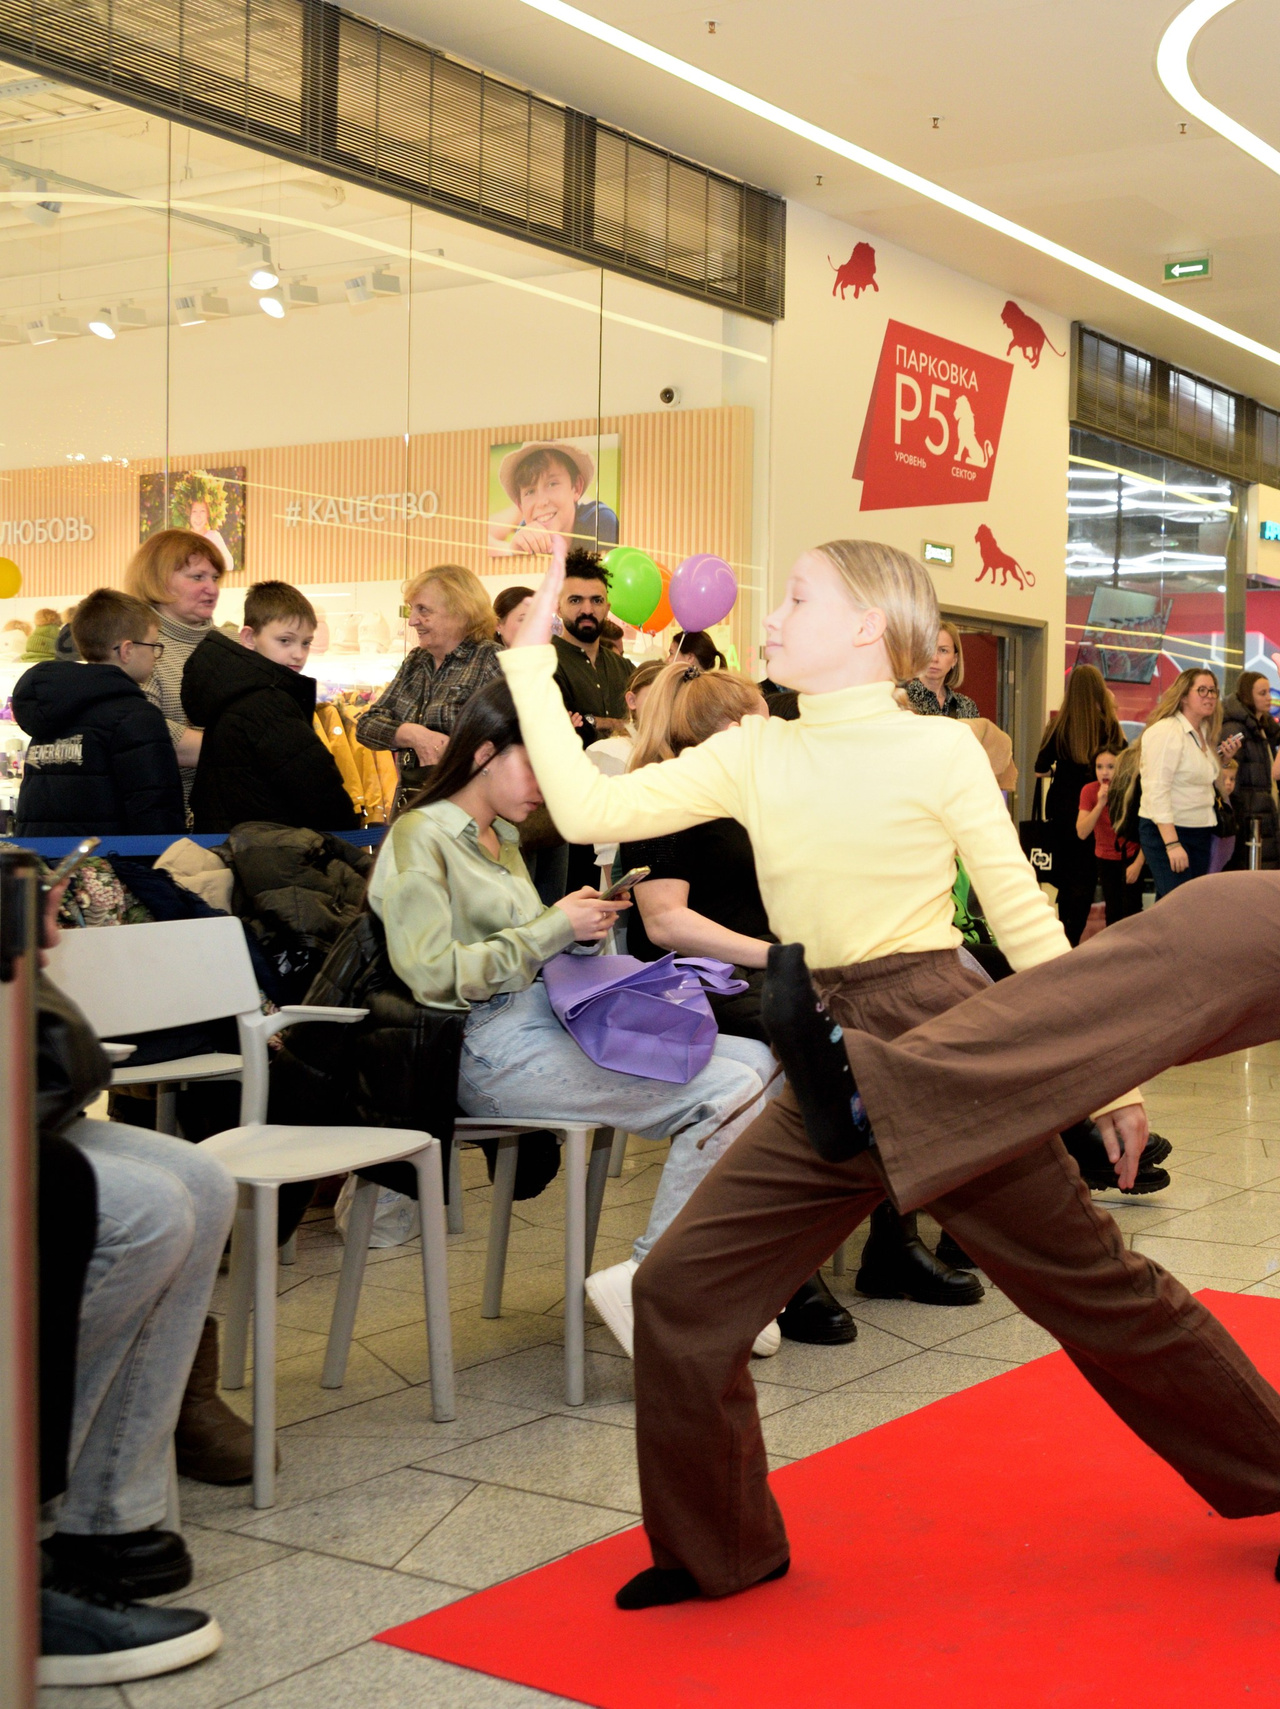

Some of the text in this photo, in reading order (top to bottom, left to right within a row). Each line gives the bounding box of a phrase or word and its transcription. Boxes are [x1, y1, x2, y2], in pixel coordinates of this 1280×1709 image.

[896, 344, 979, 392] ПАРКОВКА
[894, 372, 950, 456] P5
[894, 450, 927, 469] УРОВЕНЬ
[951, 466, 977, 481] СЕКТОР
